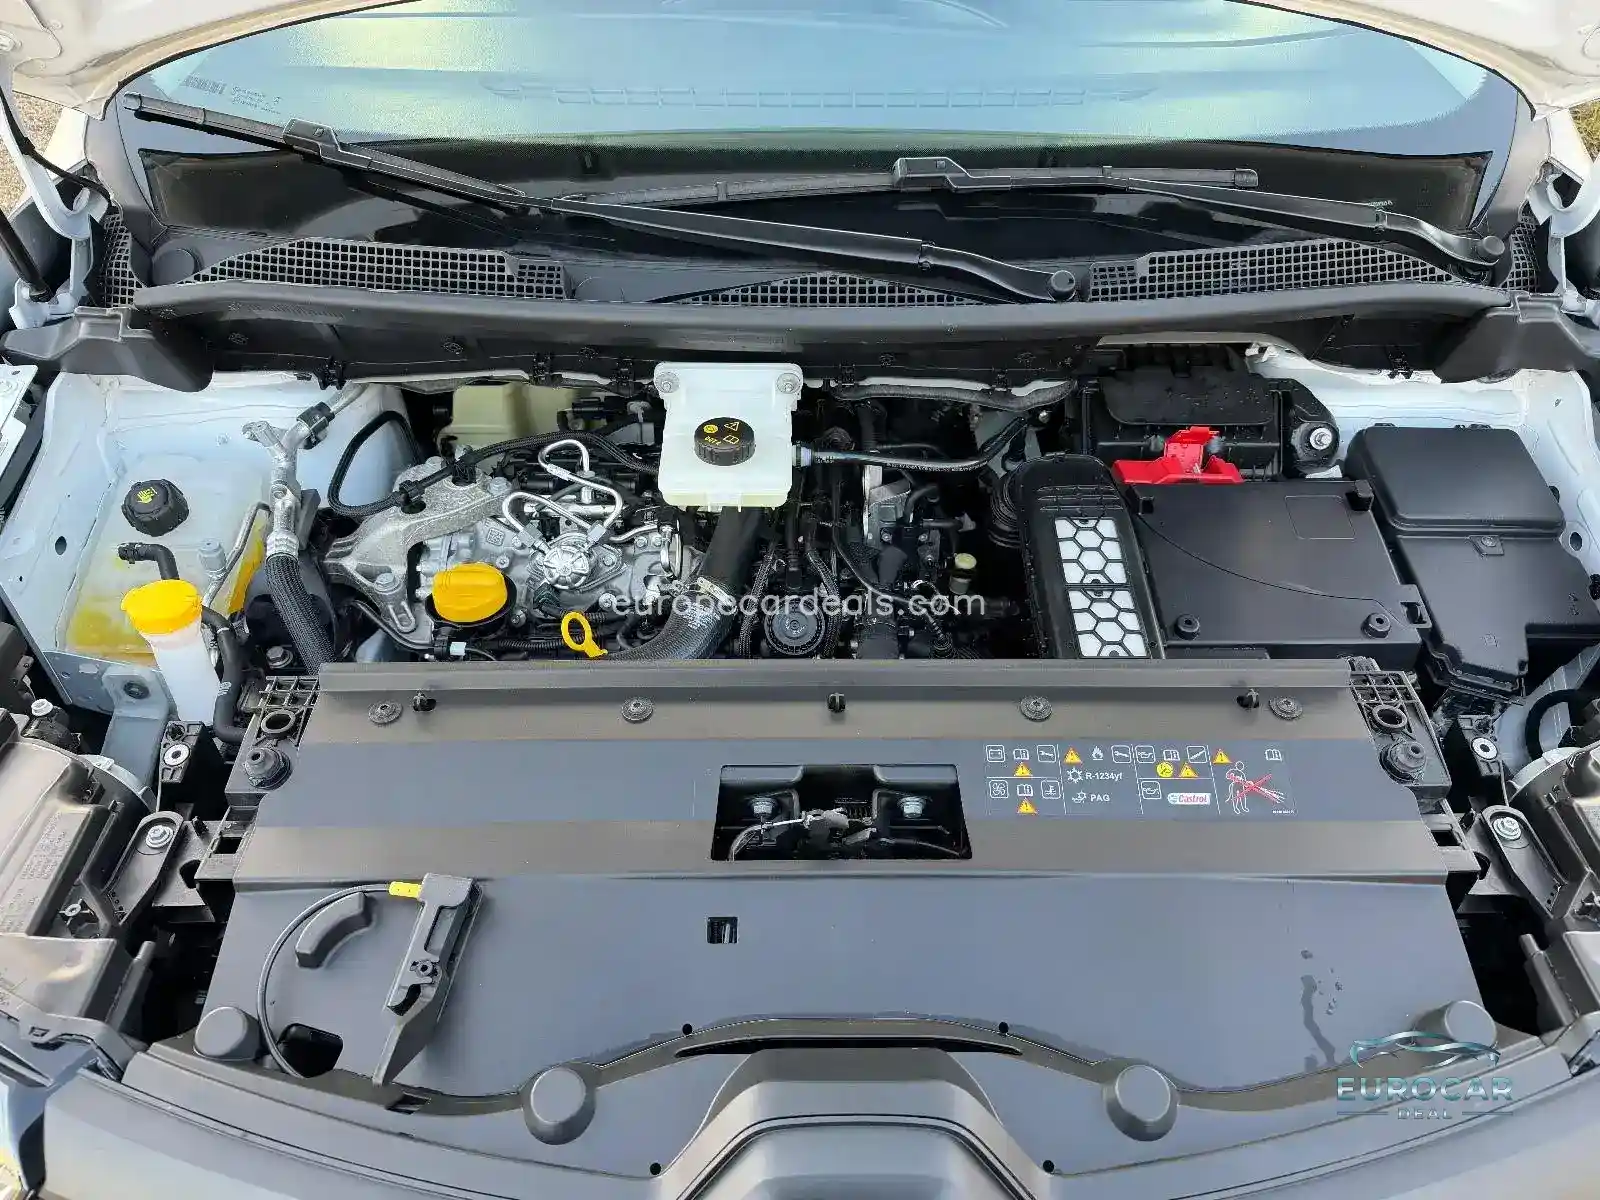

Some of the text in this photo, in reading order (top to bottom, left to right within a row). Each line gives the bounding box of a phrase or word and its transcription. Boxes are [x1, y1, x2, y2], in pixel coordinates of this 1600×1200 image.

[1085, 772, 1123, 782] R-1234yf
[1090, 793, 1110, 802] PAG
[1178, 794, 1208, 803] Castrol
